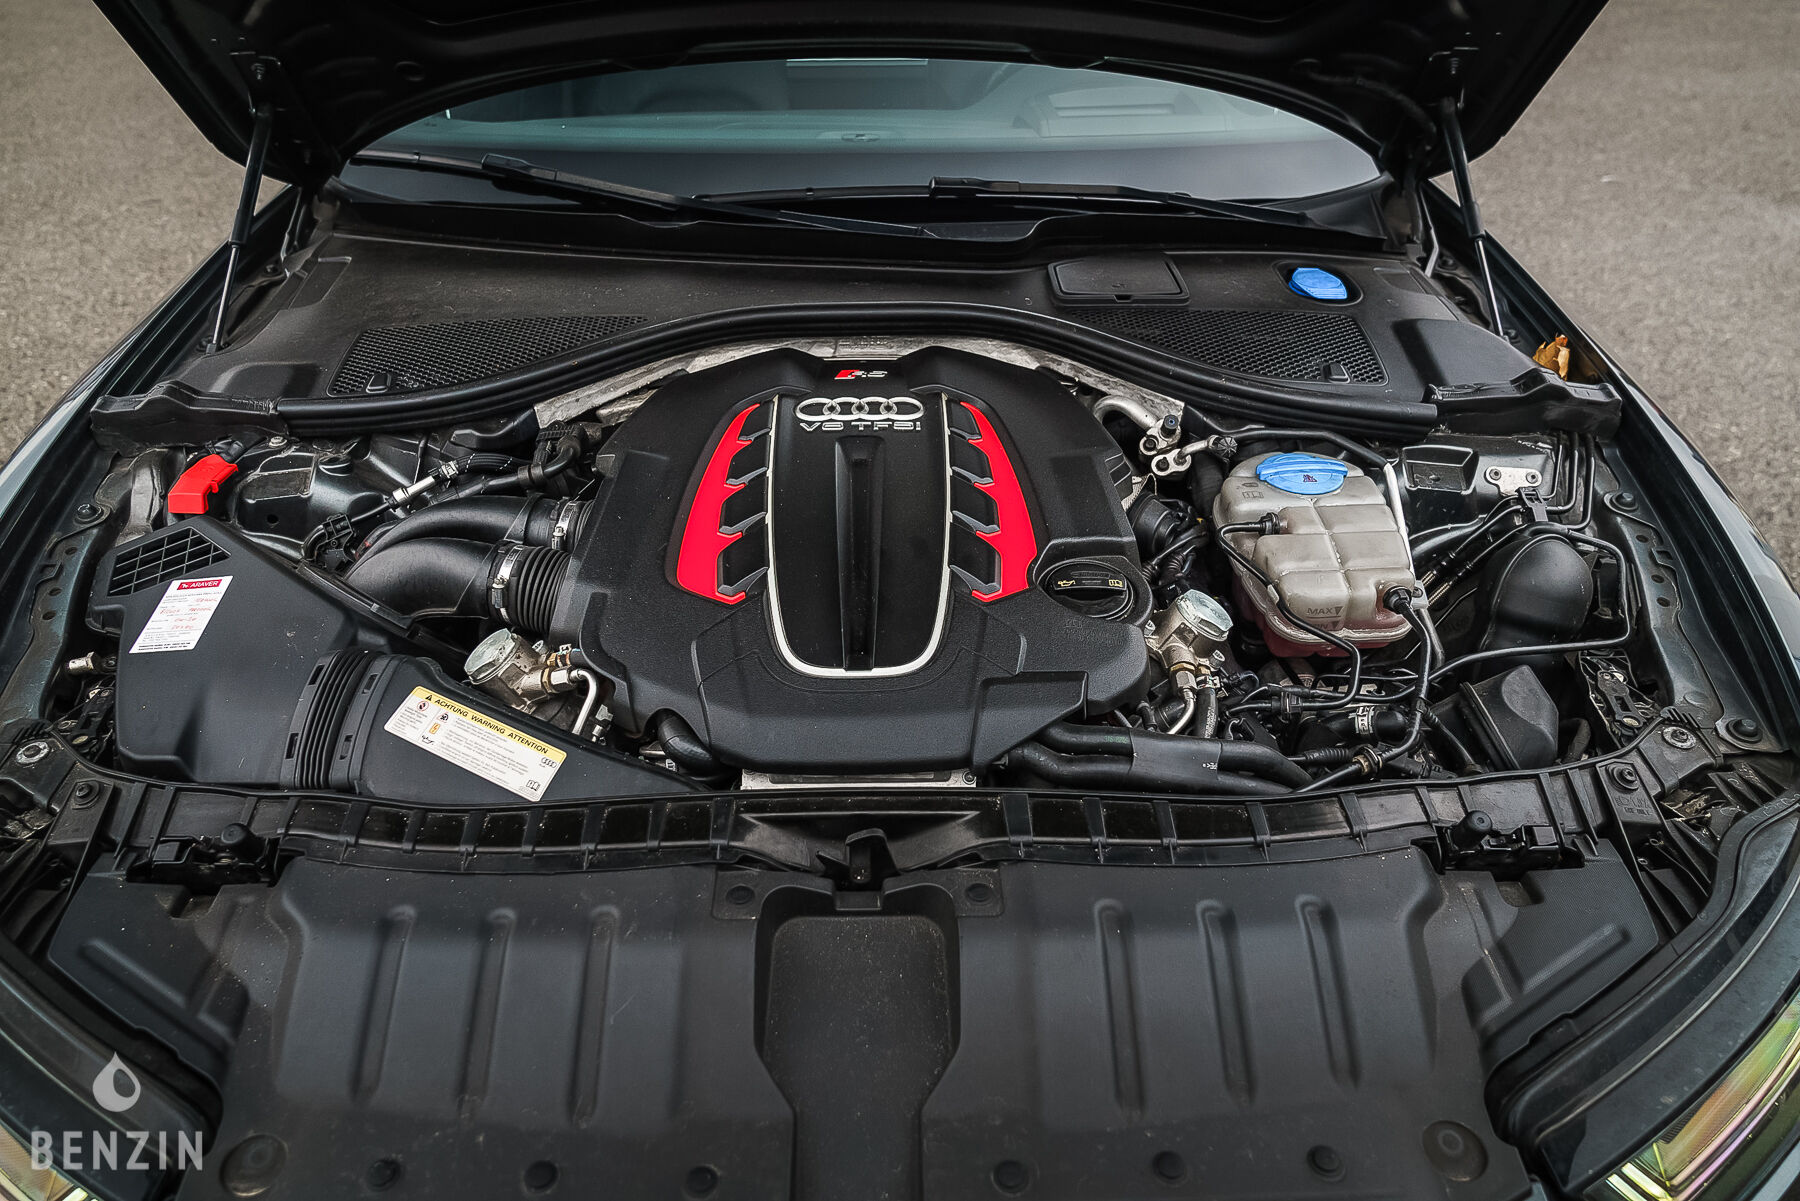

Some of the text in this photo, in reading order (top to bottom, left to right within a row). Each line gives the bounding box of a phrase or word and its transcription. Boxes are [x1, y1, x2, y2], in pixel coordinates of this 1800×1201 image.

[800, 421, 922, 431] V8 TFSI
[189, 580, 219, 588] ARAVER
[1307, 607, 1333, 615] MAX
[434, 699, 469, 717] ACHTUNG
[471, 714, 506, 734] WARNING
[507, 732, 549, 754] ATTENTION
